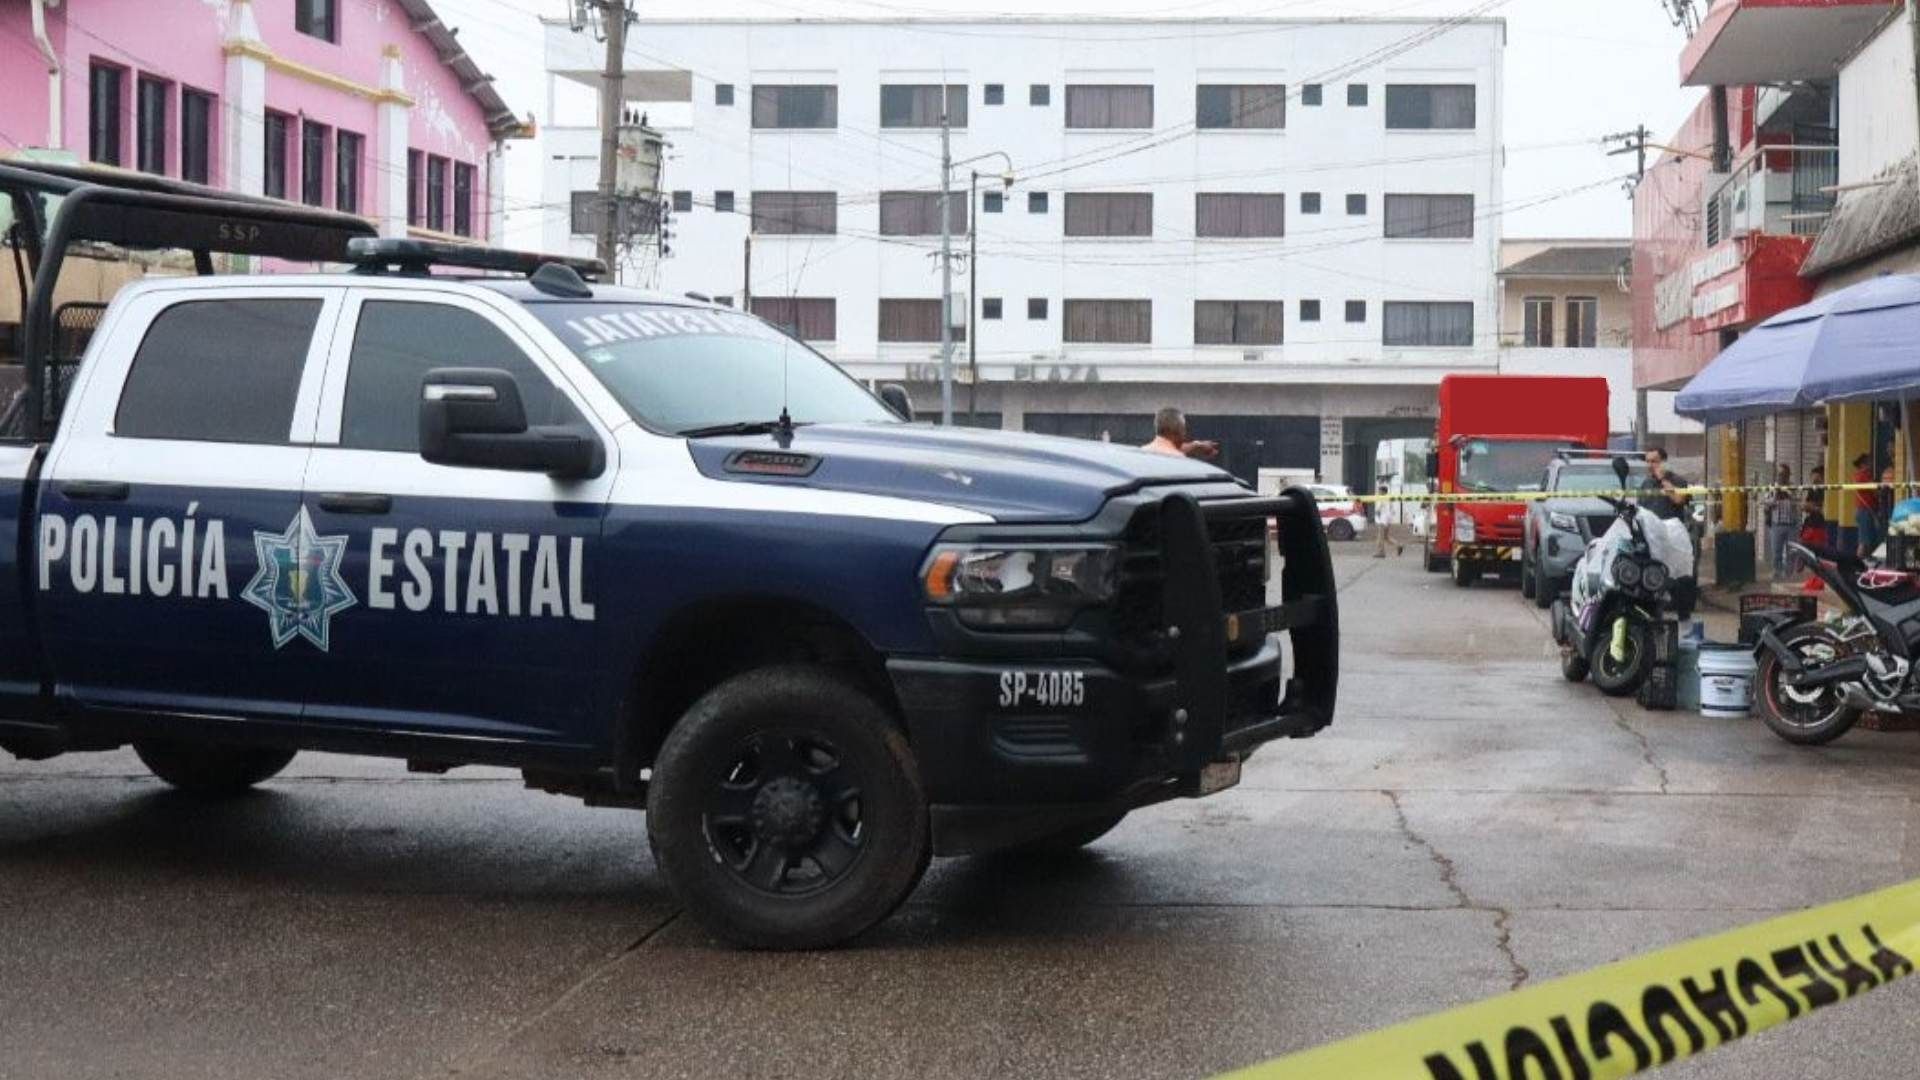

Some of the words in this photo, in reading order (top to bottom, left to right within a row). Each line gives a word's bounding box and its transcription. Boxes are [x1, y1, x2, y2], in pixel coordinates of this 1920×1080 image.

[1014, 364, 1100, 382] PLAZA
[38, 502, 229, 599] POLICÍA
[368, 527, 595, 620] ESTATAL
[1000, 671, 1084, 706] SP-4085
